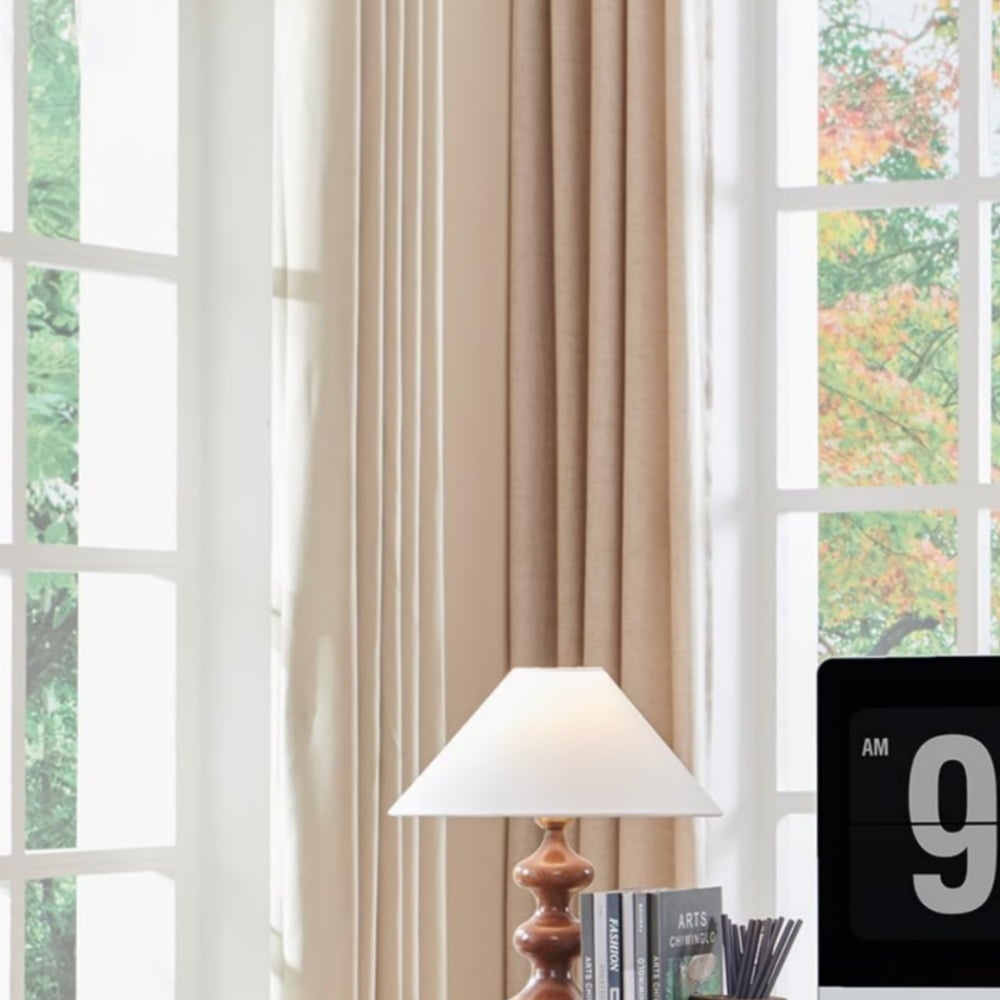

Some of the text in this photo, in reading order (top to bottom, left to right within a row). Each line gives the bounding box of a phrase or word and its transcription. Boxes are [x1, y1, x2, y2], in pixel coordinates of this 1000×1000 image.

[862, 738, 889, 757] AM
[908, 734, 998, 915] 9
[678, 911, 708, 929] ARTS
[609, 918, 619, 972] FASHION
[584, 955, 593, 980] ARTS
[652, 955, 660, 980] ARTS
